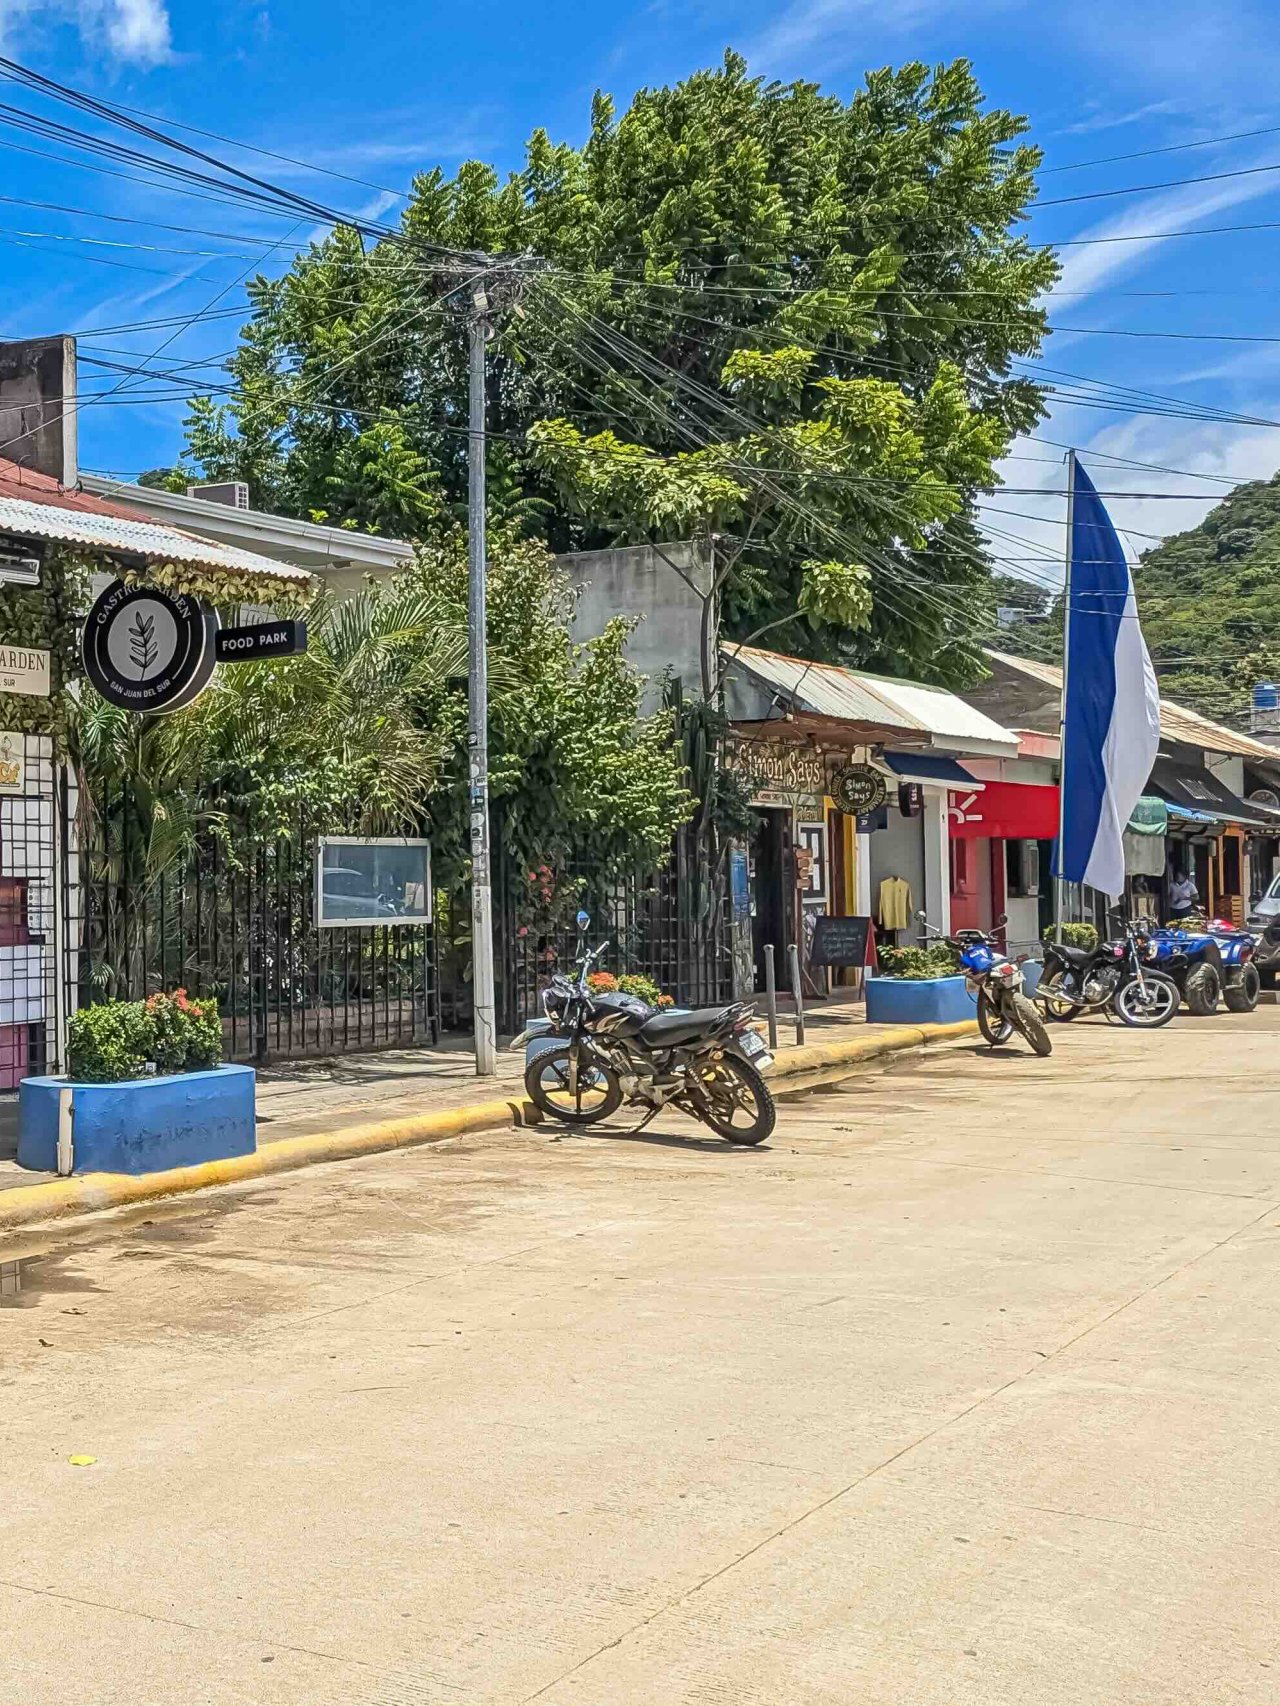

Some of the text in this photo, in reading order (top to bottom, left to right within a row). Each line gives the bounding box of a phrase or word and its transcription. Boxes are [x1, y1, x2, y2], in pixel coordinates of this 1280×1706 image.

[222, 631, 288, 651] FOOD PARK
[3, 678, 16, 687] SUR
[109, 679, 172, 699] SAN JUAN DEL SUR
[739, 744, 821, 793] Simon Says
